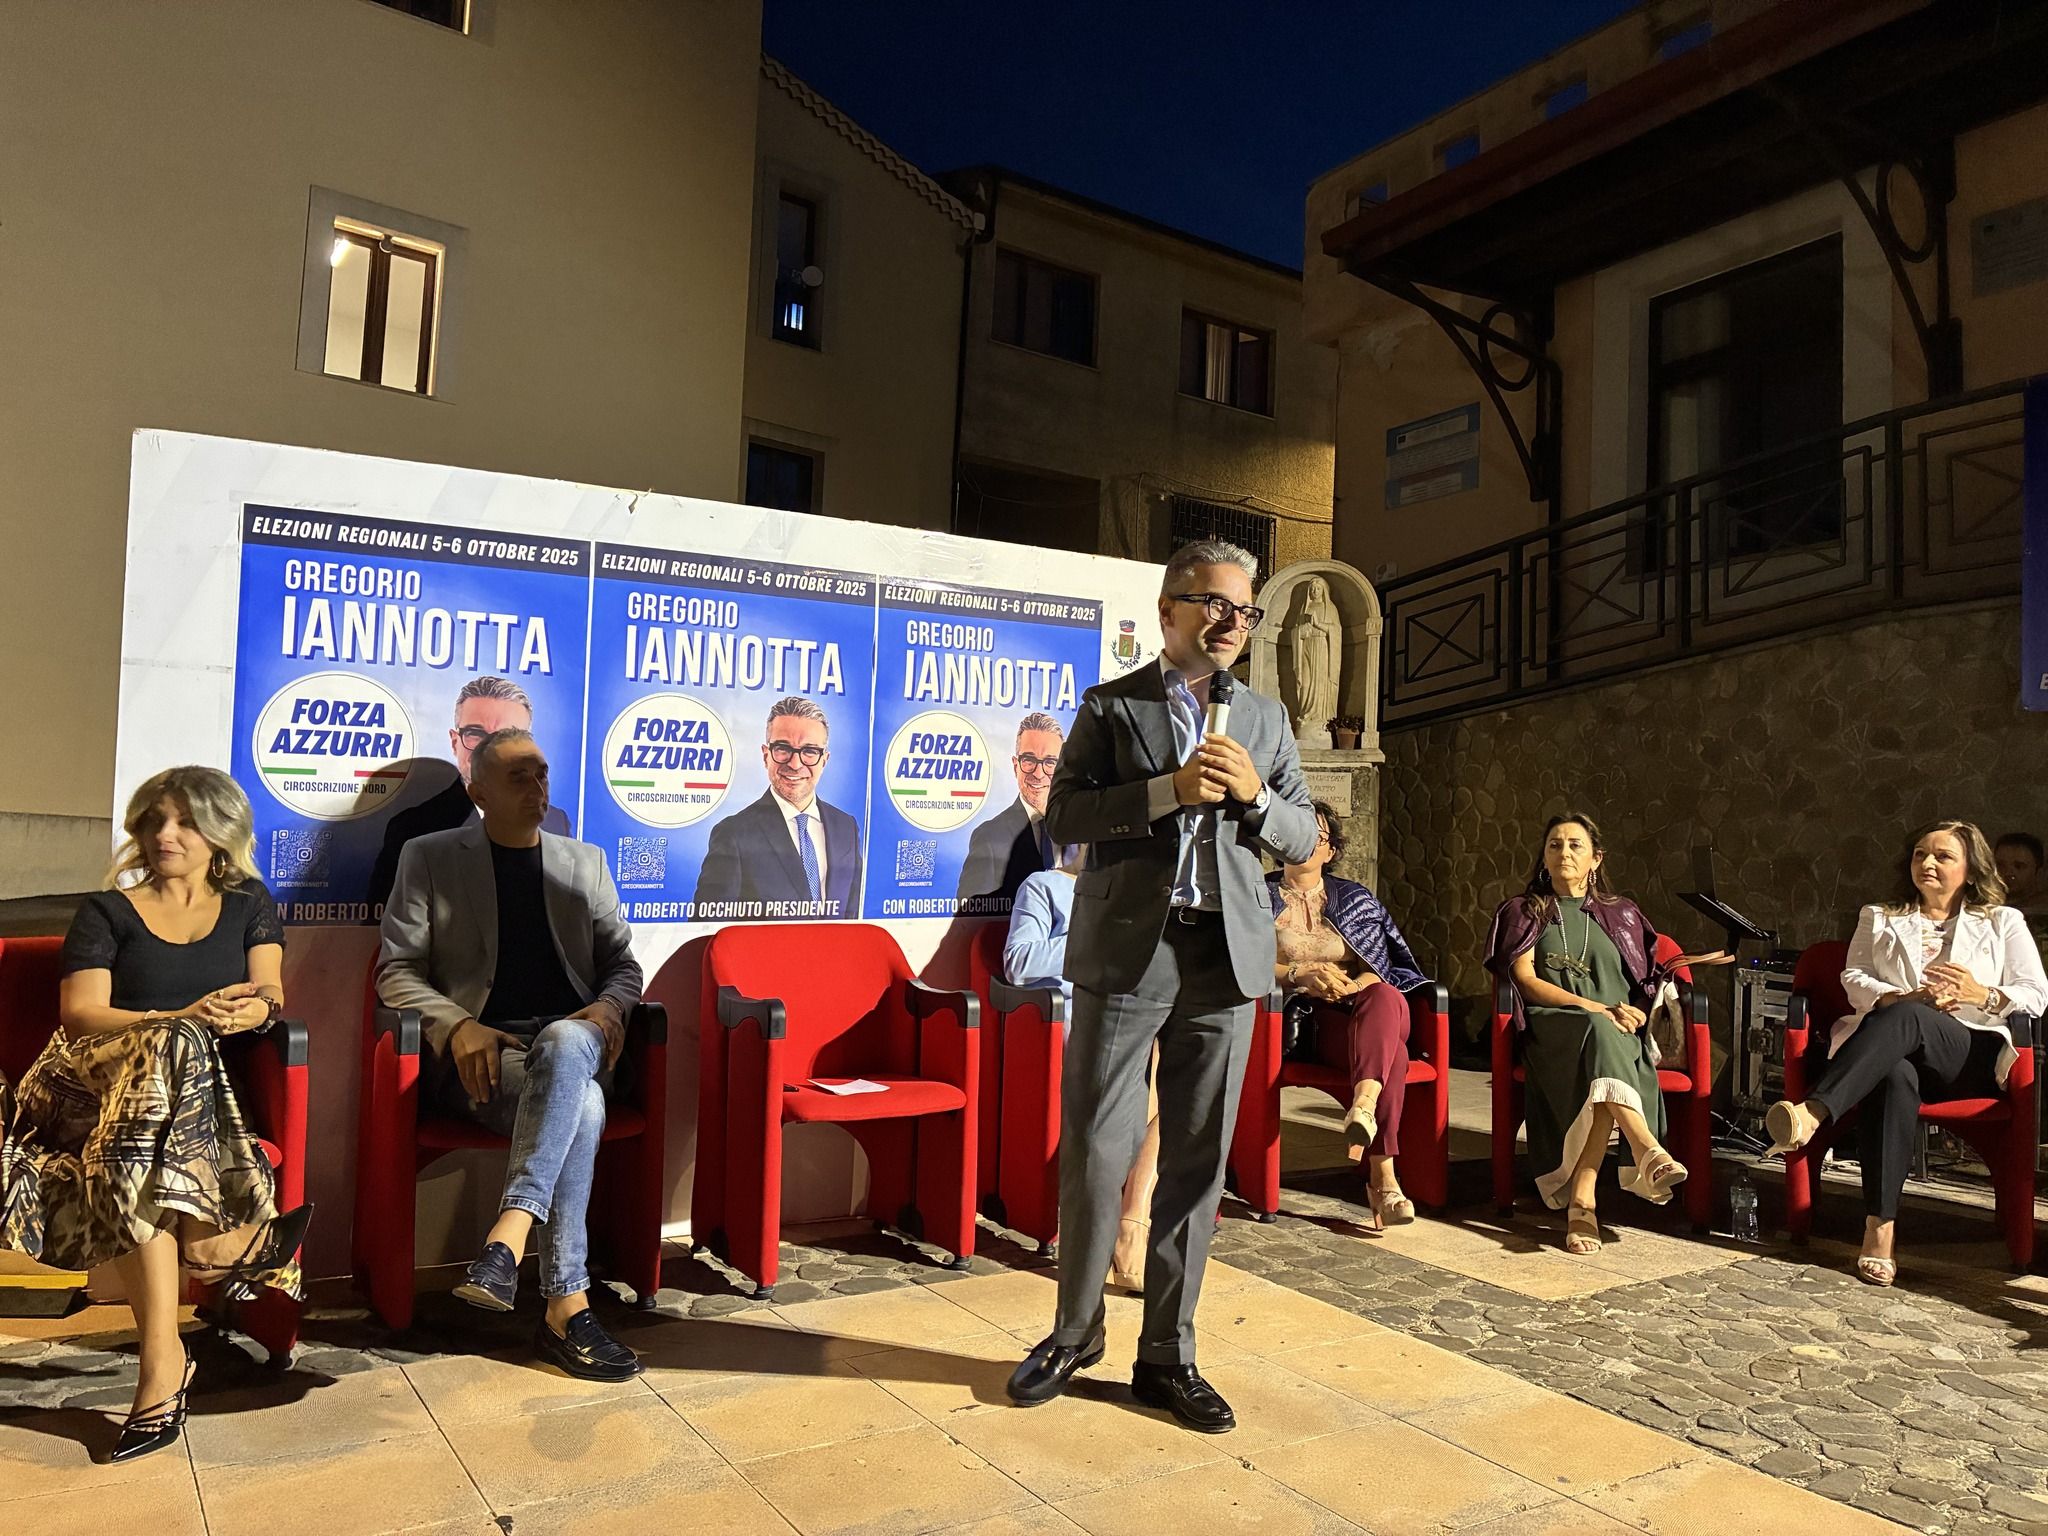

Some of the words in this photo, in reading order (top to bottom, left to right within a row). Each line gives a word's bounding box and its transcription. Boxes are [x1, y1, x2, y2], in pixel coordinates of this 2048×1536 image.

[252, 516, 332, 541] ELEZIONI
[337, 525, 428, 550] REGIONALI
[432, 536, 462, 552] 5-6
[467, 539, 536, 561] OTTOBRE
[541, 548, 579, 566] 2025
[285, 559, 421, 600] GREGORIO
[601, 553, 667, 575] ELEZIONI
[671, 560, 743, 583] REGIONALI
[746, 571, 771, 586] 5-6
[775, 574, 832, 592] OTTOBRE
[835, 580, 867, 597] 2025
[627, 591, 739, 628] GREGORIO
[885, 585, 937, 605] ELEZIONI
[939, 591, 998, 611] REGIONALI
[1000, 599, 1020, 613] 5-6
[1023, 602, 1068, 619] OTTOBRE
[1070, 607, 1096, 622] 2025
[281, 595, 552, 675] IANNOTTA
[906, 619, 994, 652] GREGORIO
[625, 624, 845, 696] IANNOTTA
[903, 649, 1077, 711] IANNOTTA
[291, 698, 385, 728] FORZA
[269, 729, 403, 759] AZZURRI
[633, 717, 710, 744] FORZA
[909, 733, 972, 757] FORZA
[616, 744, 723, 772] AZZURRI
[896, 758, 983, 781] AZZURRI
[283, 780, 359, 794] CIRCOSCRIZIONE
[362, 783, 386, 795] NORD
[627, 792, 689, 804] CIRCOSCRIZIONE
[691, 793, 711, 804] NORD
[905, 799, 955, 810] CIRCOSCRIZIONE
[956, 801, 973, 810] NORD
[293, 902, 369, 921] ROBERTO
[633, 902, 695, 919] ROBERTO
[698, 901, 762, 918] OCCHIUTO
[765, 900, 840, 917] PRESIDENTE
[883, 899, 905, 915] CON
[909, 898, 959, 914] ROBERTO
[961, 897, 1012, 912] OCCHIUTO
